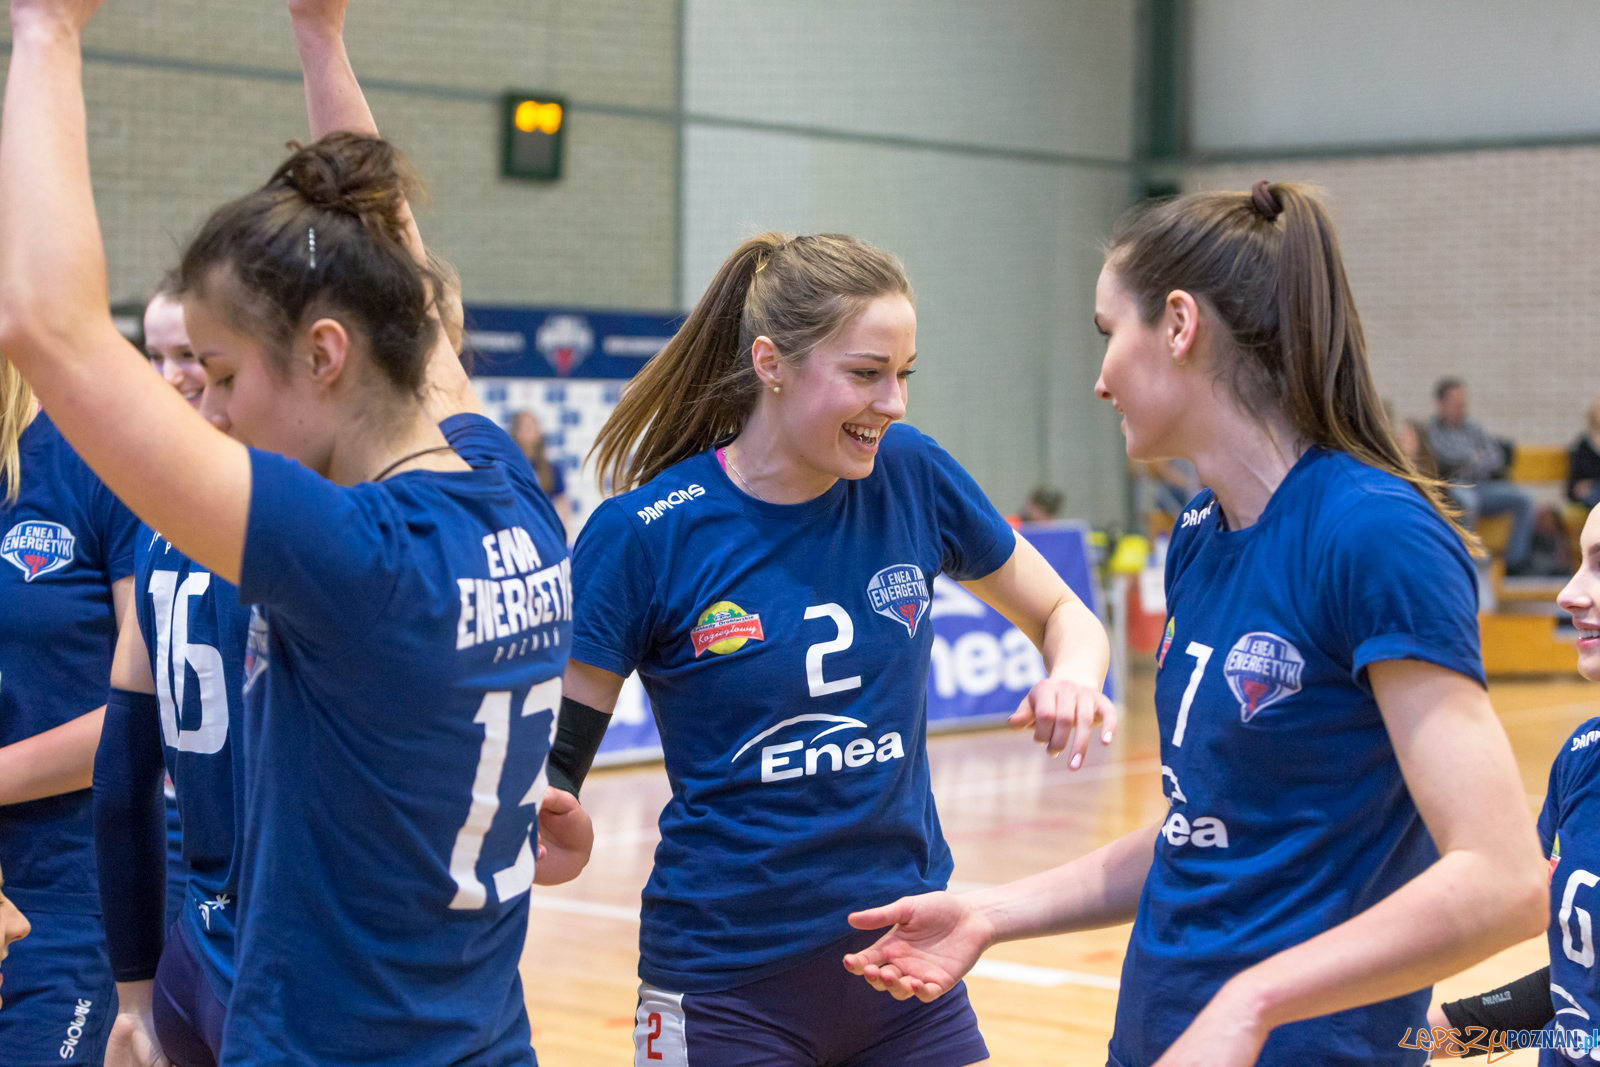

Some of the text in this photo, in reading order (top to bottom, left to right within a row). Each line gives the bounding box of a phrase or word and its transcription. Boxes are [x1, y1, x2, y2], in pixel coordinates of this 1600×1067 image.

[637, 484, 706, 525] DAMONS
[4, 536, 70, 557] ENERGETYK
[25, 525, 53, 539] ENEA
[871, 580, 929, 608] ENERGETYK
[888, 570, 911, 586] ENEA
[148, 570, 229, 755] 16
[804, 603, 862, 698] 2
[1250, 639, 1275, 659] ENEA
[1227, 653, 1301, 686] ENERGETYK
[1171, 641, 1214, 747] 7
[761, 731, 905, 783] Enea
[448, 676, 563, 910] 13
[1162, 812, 1229, 848] ea
[647, 1012, 663, 1061] 2
